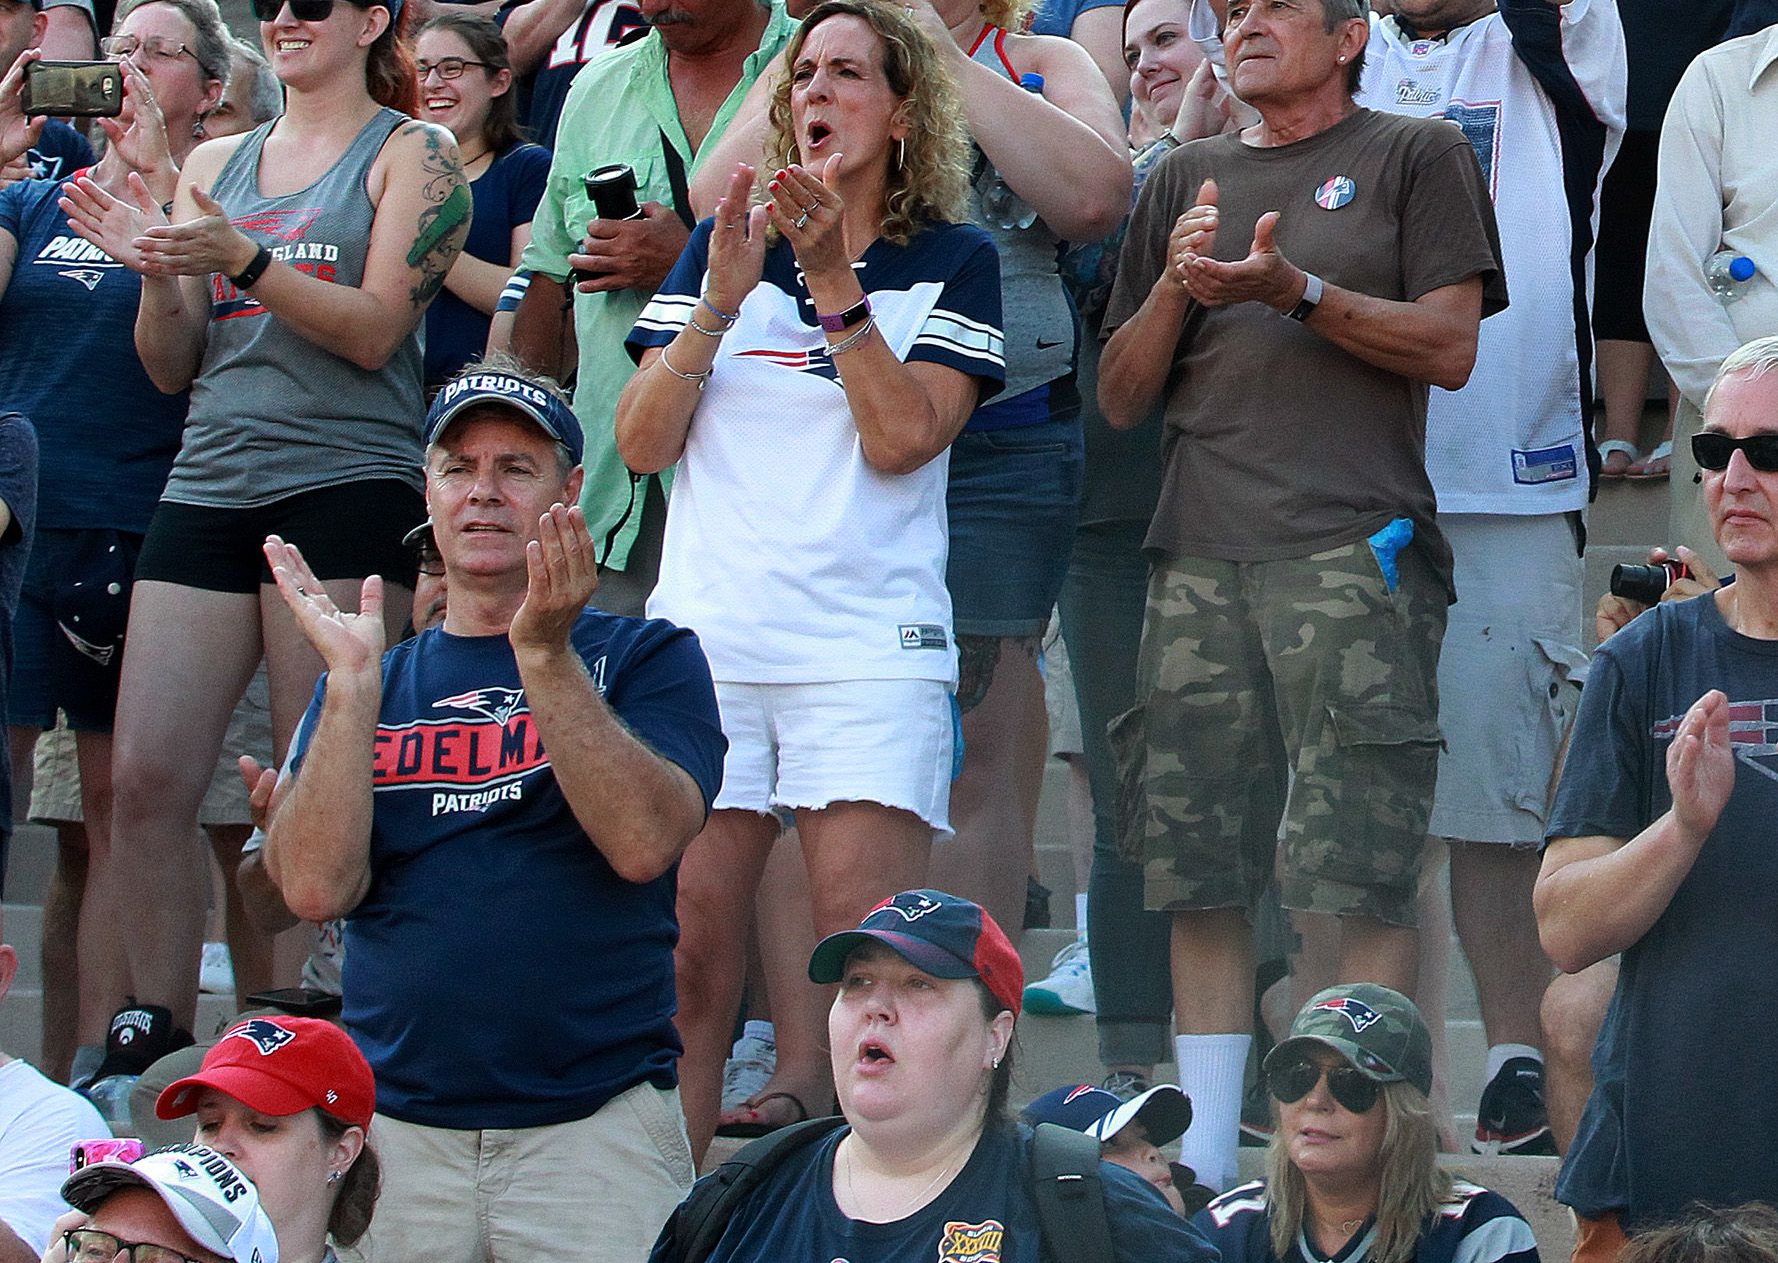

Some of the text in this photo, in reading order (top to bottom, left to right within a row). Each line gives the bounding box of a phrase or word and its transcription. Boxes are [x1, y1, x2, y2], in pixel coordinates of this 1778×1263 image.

[265, 243, 339, 263] GLAND
[444, 374, 549, 408] PATRIOTS
[433, 780, 523, 817] PATRIOTS
